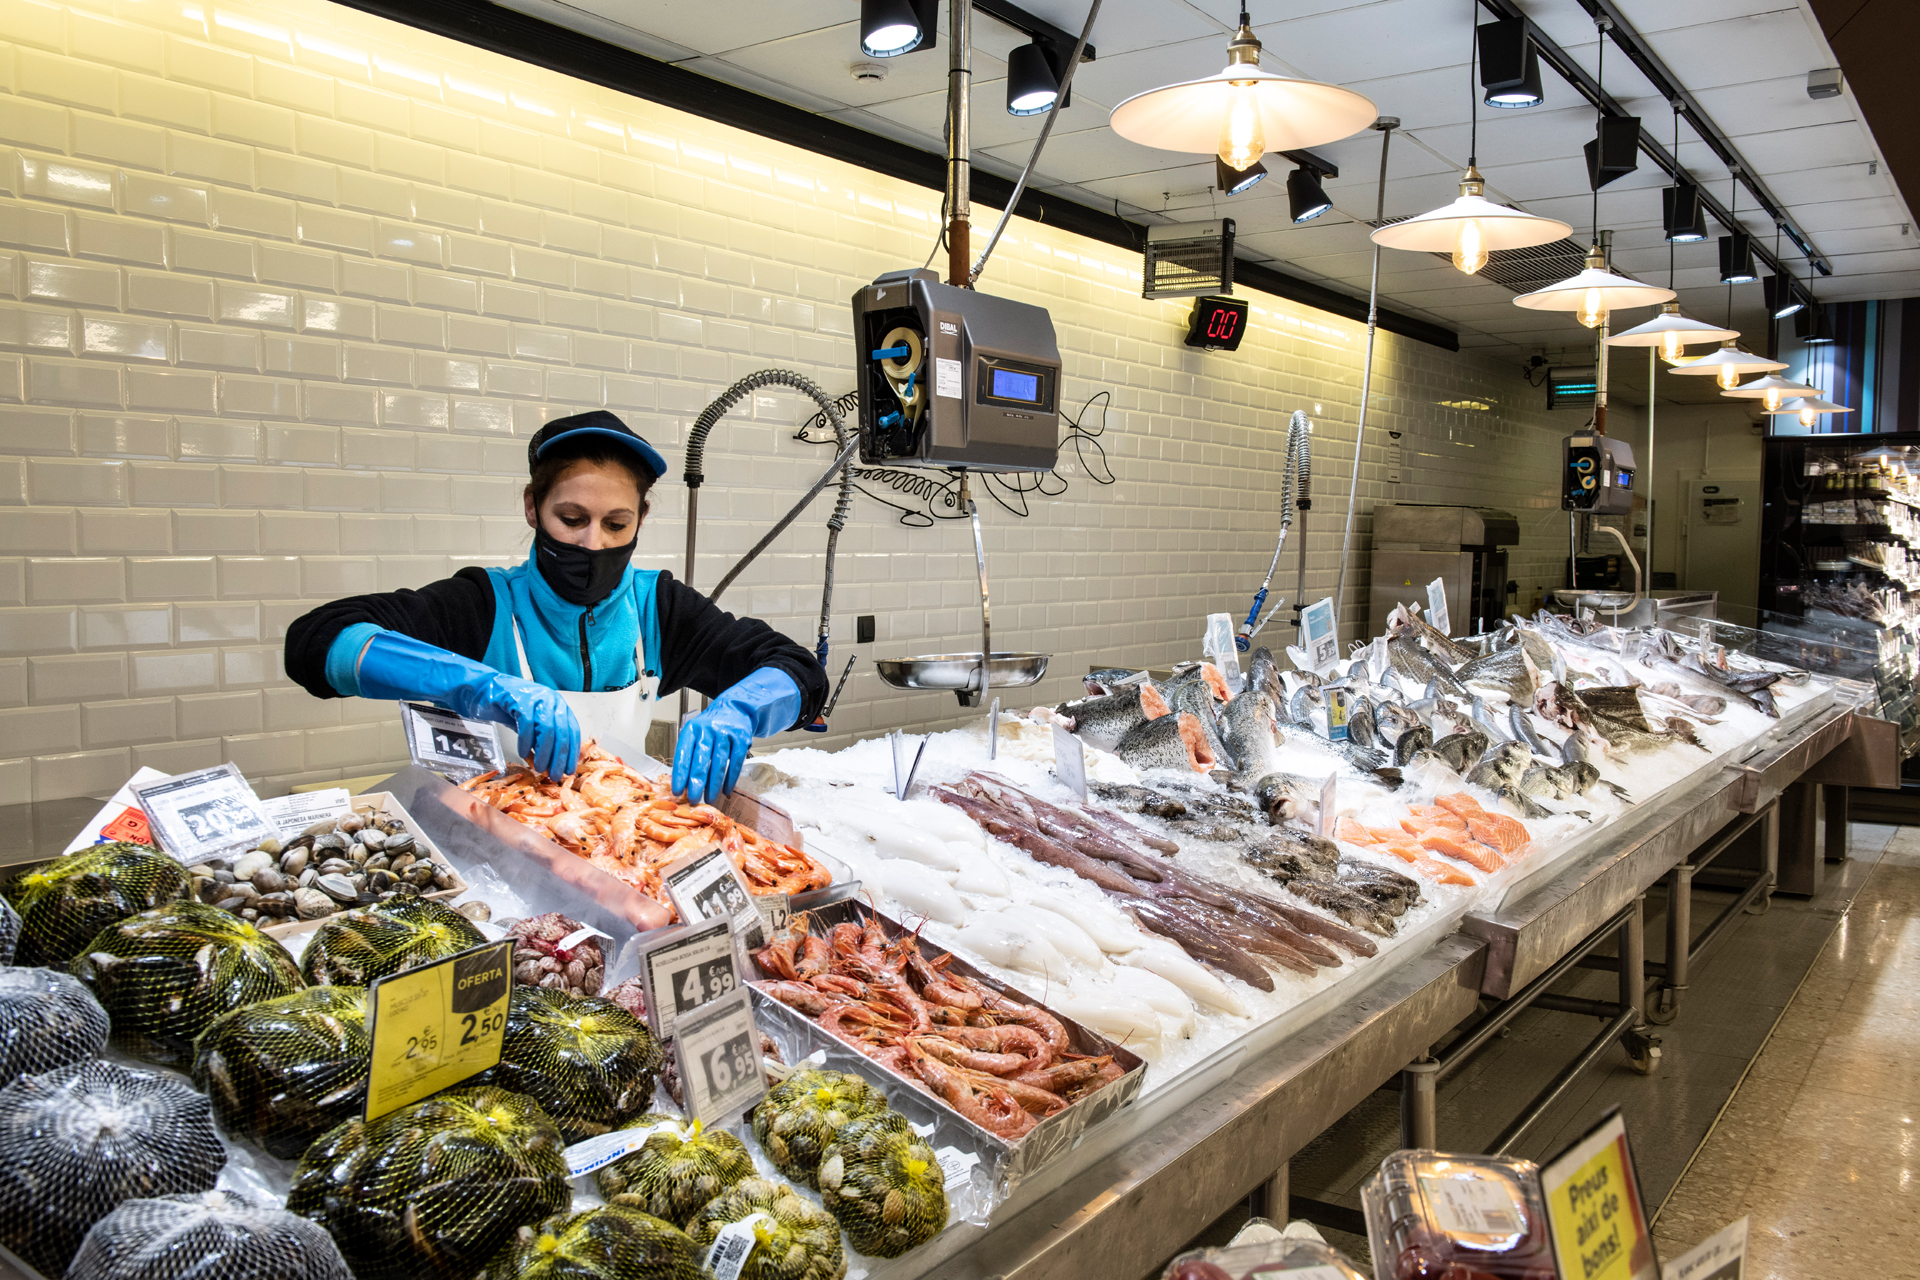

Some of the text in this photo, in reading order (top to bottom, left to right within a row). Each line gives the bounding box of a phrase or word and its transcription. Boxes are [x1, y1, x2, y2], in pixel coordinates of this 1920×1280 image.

[940, 321, 957, 332] DIBAL
[1207, 309, 1238, 339] 00
[282, 816, 307, 826] JAPONESA
[458, 968, 502, 990] OFERTA
[682, 966, 734, 1006] 4,99
[460, 1013, 503, 1046] 2,50
[406, 1036, 437, 1060] 2,95
[710, 1044, 755, 1091] 6,95
[1568, 1165, 1608, 1214] Preus
[1602, 1192, 1619, 1222] de
[1580, 1222, 1621, 1279] bons!
